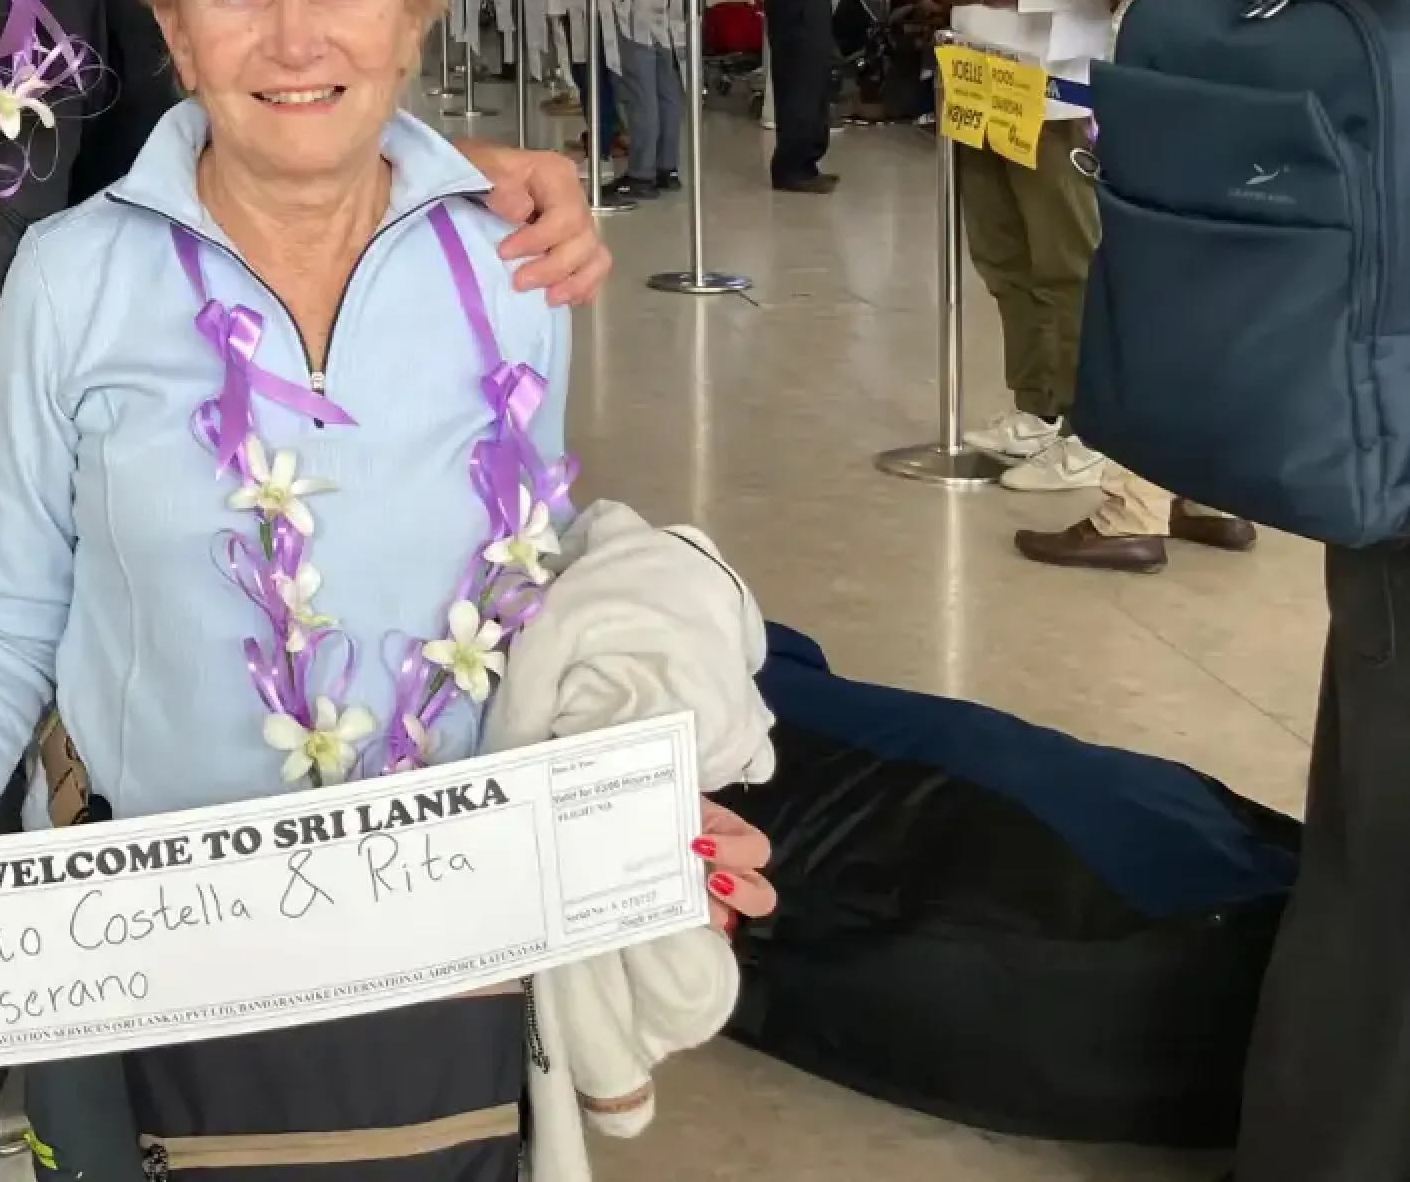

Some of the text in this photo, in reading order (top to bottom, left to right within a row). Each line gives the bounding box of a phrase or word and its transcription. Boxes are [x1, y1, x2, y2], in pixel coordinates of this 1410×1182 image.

[201, 825, 263, 861] TO
[273, 809, 347, 850] SRI
[355, 777, 510, 834] LANKA
[69, 882, 252, 951] Costella
[279, 848, 335, 919] &
[357, 831, 475, 903] Rita
[239, 990, 331, 1013] BANDARANAIKE
[333, 971, 425, 998] INTERNATIONAL
